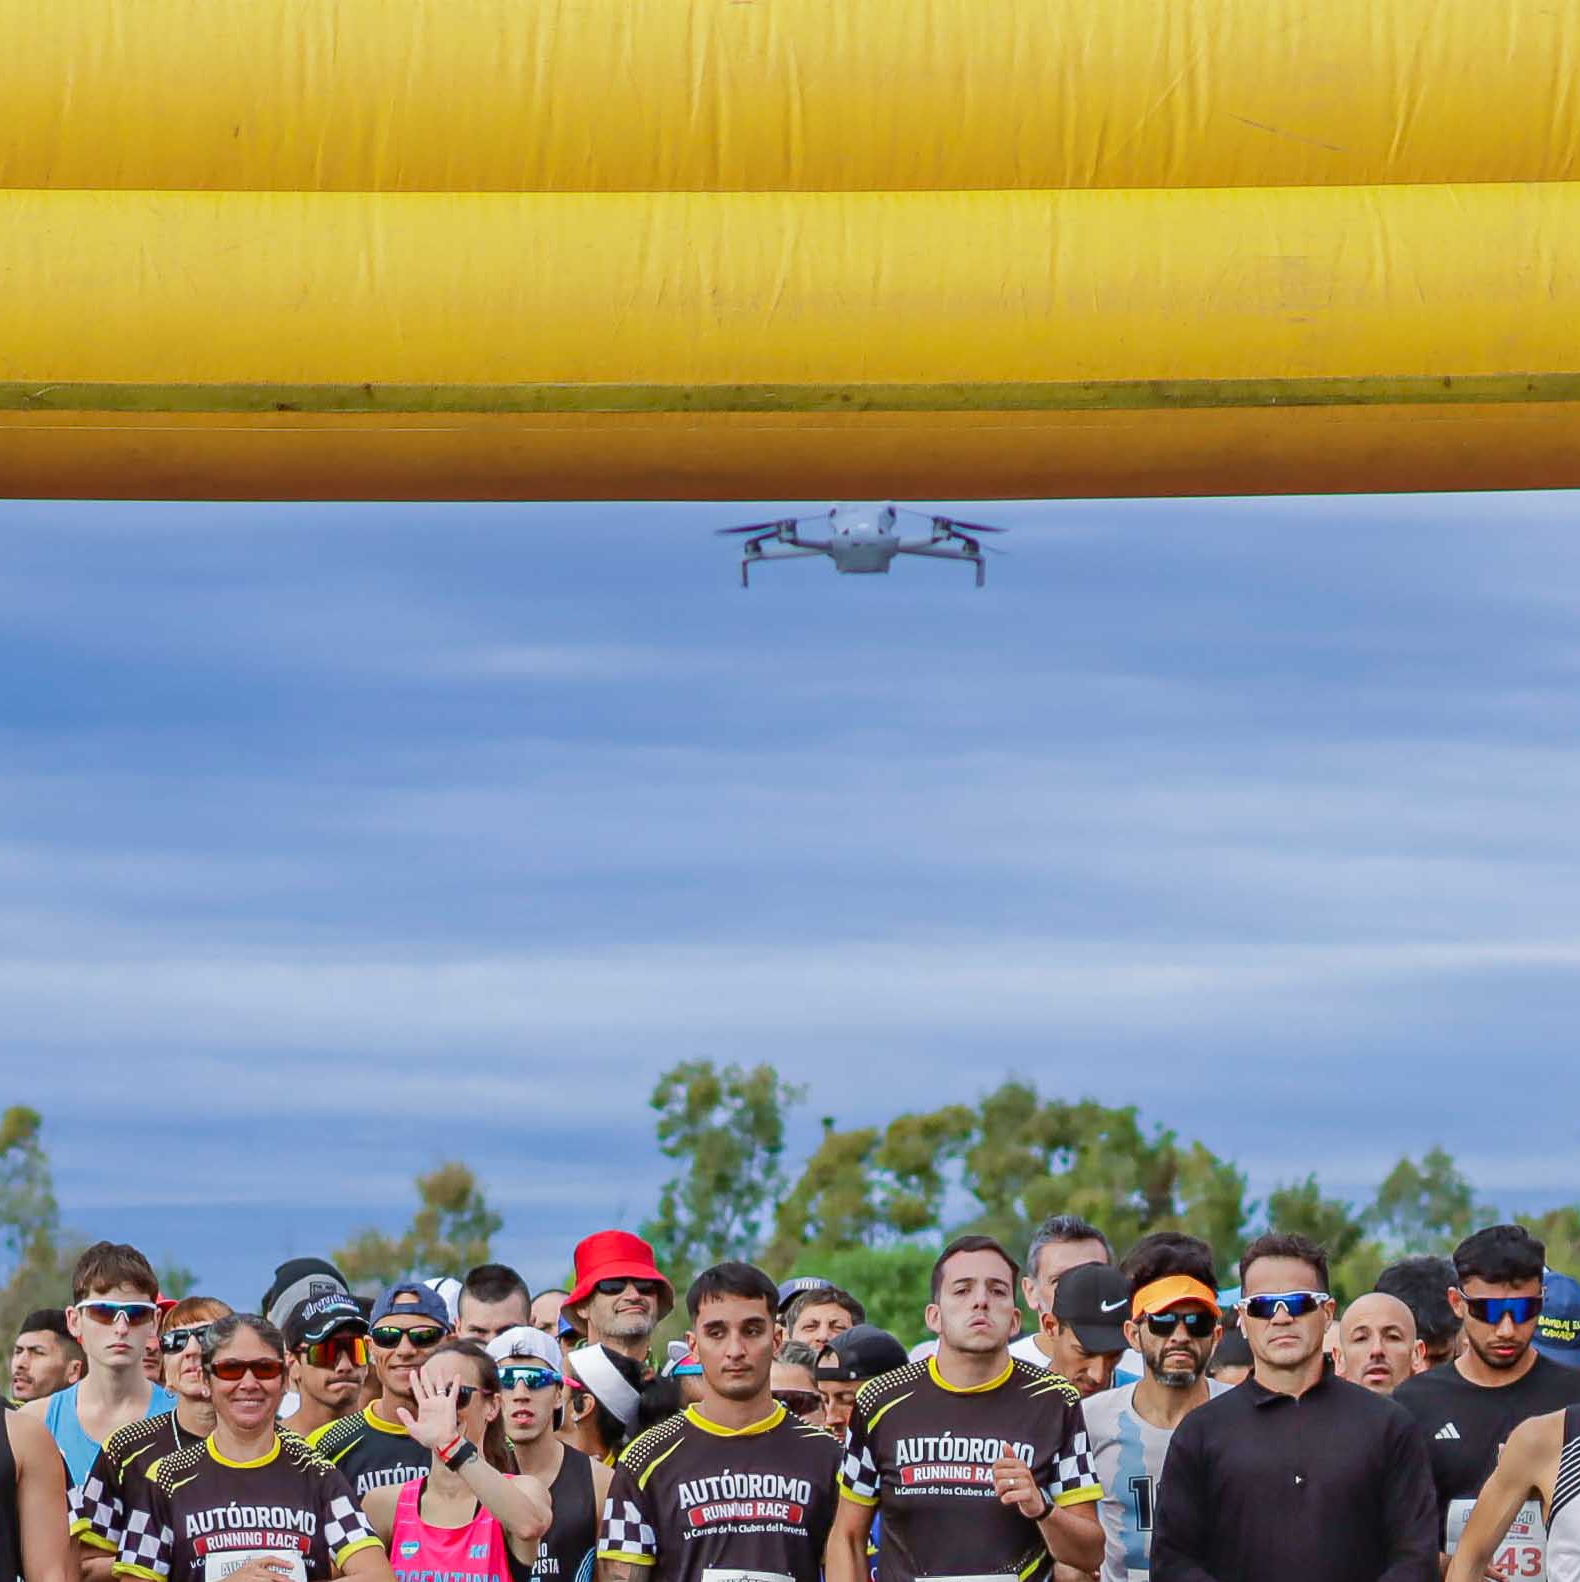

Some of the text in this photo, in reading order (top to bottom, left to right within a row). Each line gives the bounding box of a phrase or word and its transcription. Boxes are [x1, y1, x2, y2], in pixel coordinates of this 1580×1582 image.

[914, 1465, 972, 1482] RUNNING
[678, 1468, 812, 1510] AUTÓDROMO
[928, 1486, 940, 1495] de
[941, 1486, 953, 1496] los
[954, 1487, 983, 1496] Clubes
[185, 1501, 317, 1539] AUTÓDROMO
[702, 1502, 790, 1522] RUNNING RACE
[738, 1523, 765, 1533] Clubes
[206, 1532, 300, 1551] RUNNING RACE
